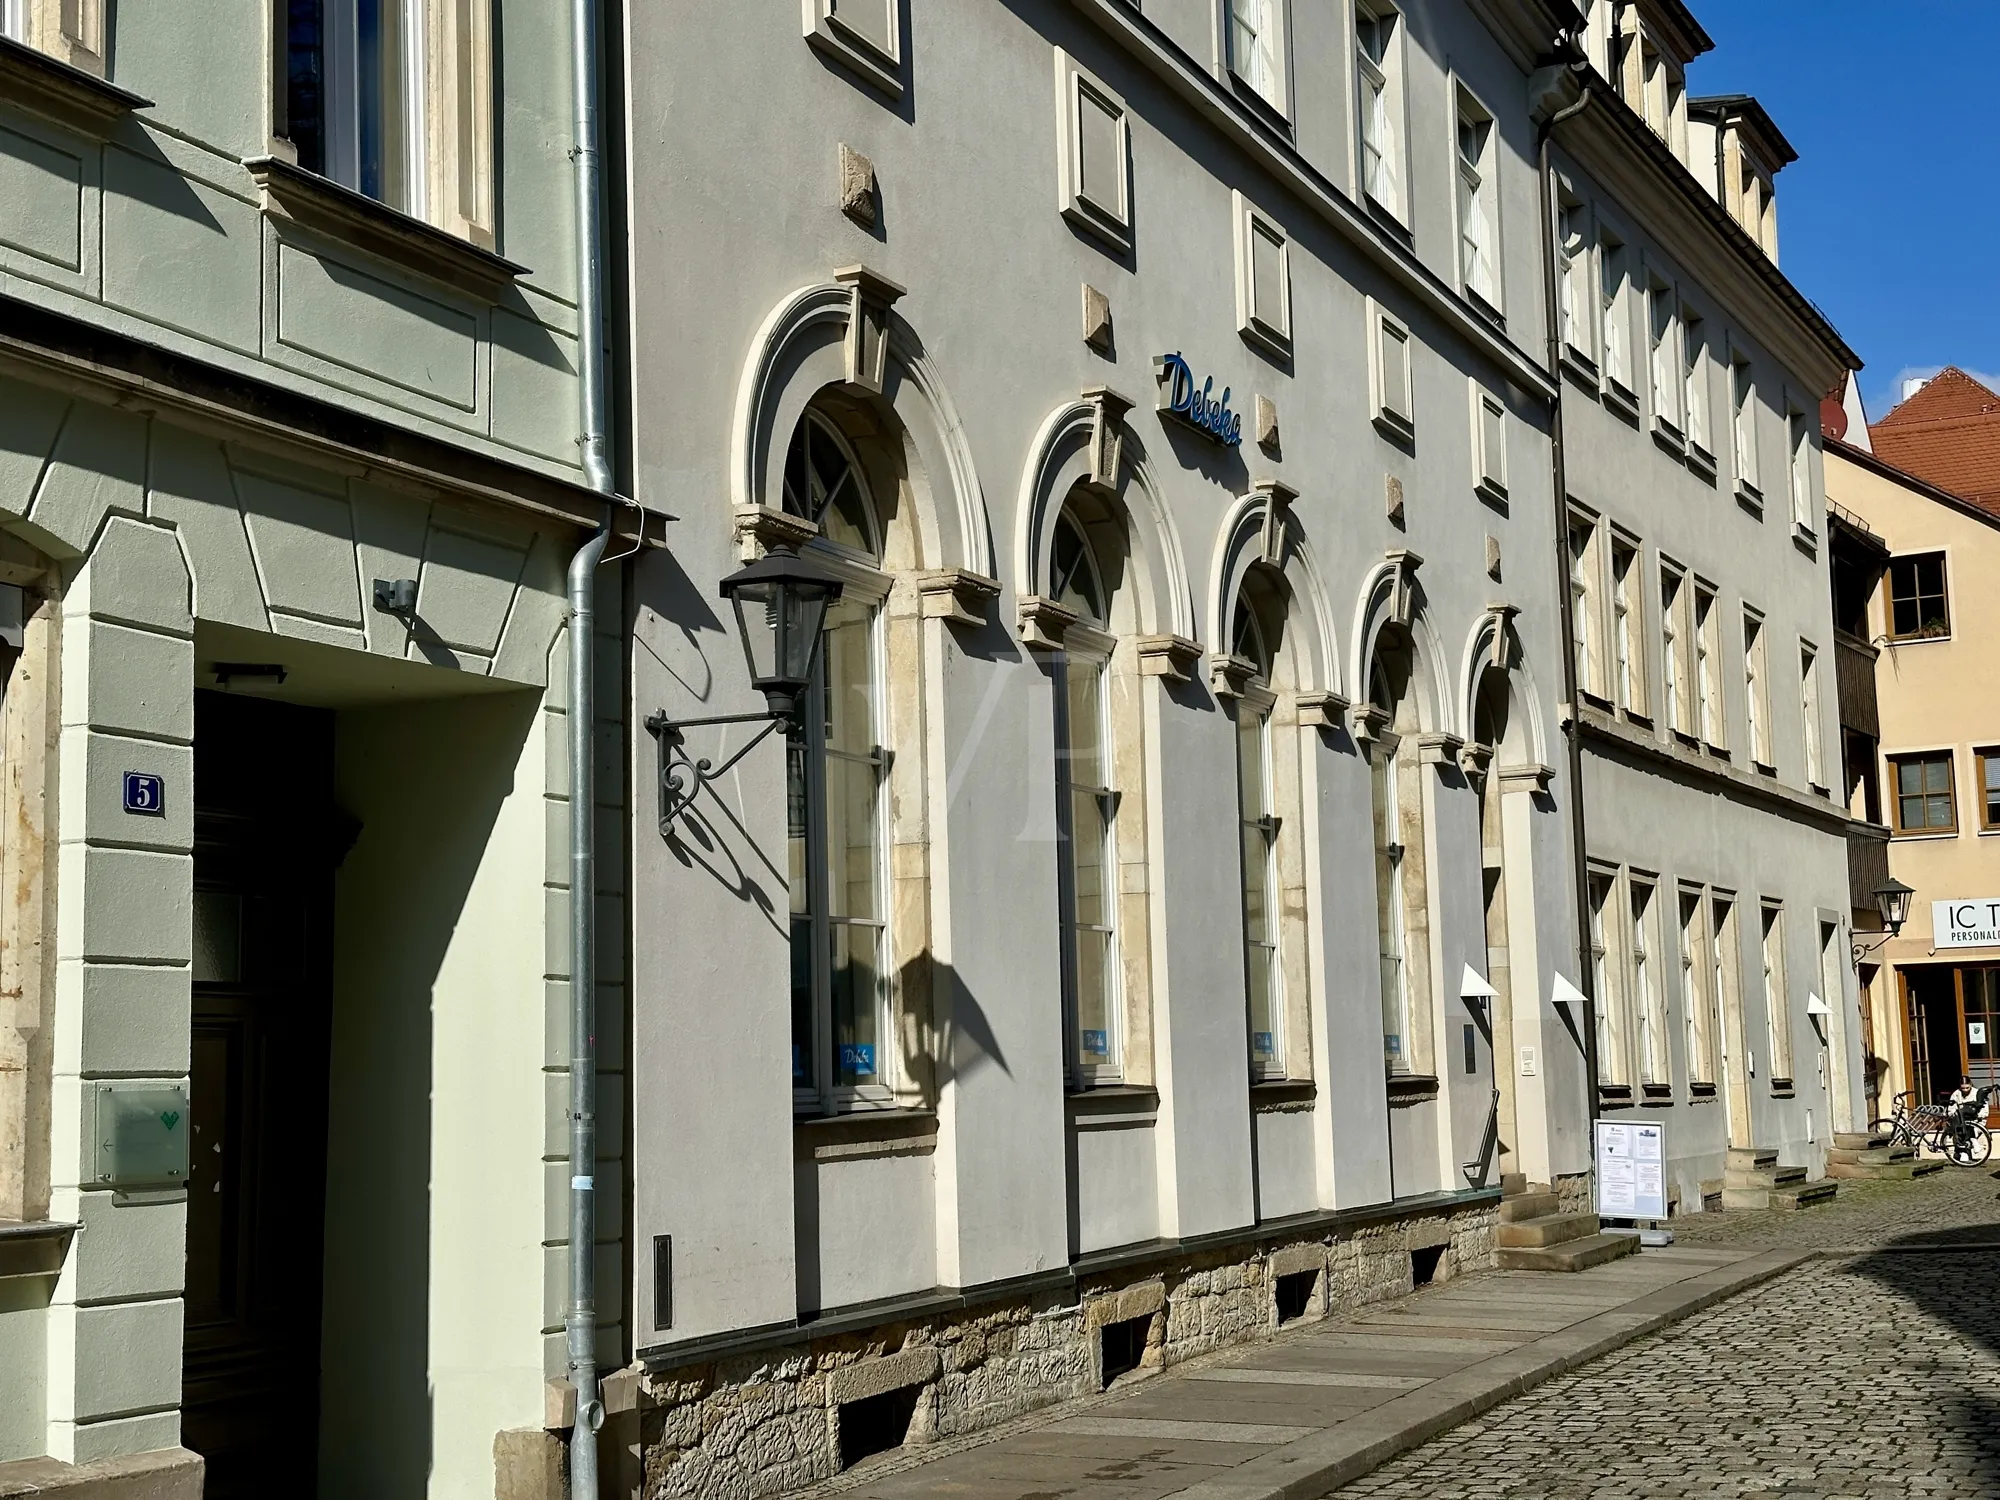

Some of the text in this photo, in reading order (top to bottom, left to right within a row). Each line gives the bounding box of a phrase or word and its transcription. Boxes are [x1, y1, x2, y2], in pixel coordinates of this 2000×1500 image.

[1163, 350, 1242, 446] Debeka
[137, 778, 150, 807] 5
[1949, 905, 1976, 929] IC
